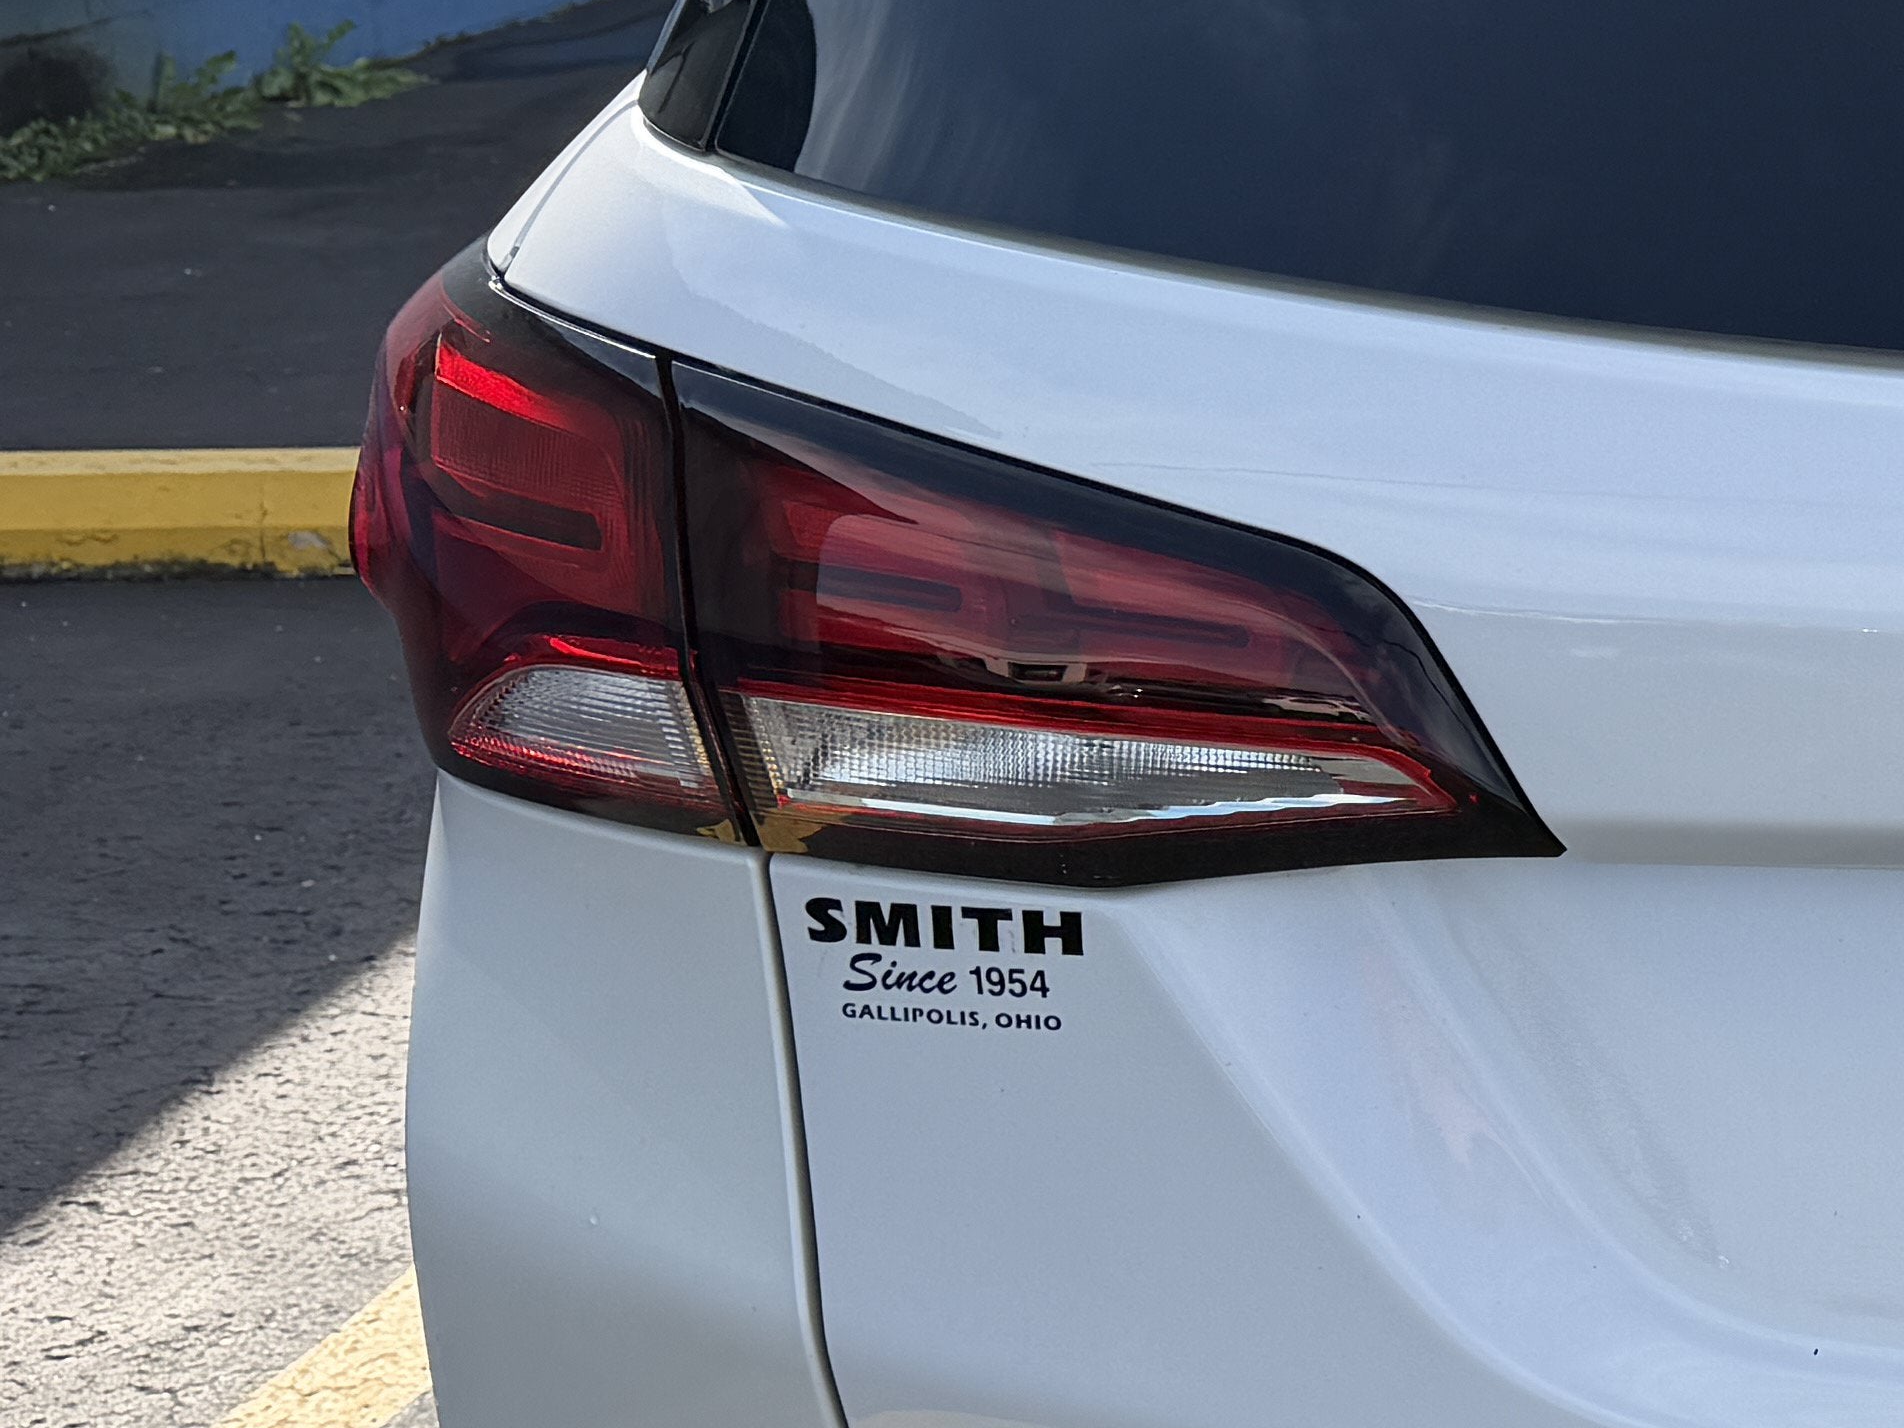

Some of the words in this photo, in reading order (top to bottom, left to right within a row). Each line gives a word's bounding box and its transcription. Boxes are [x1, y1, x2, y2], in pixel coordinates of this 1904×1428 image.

[805, 897, 1084, 956] SMITH
[843, 953, 957, 995] Since
[969, 966, 1050, 998] 1954
[842, 1003, 987, 1030] GALLIPOLIS,
[995, 1012, 1062, 1031] OHIO
